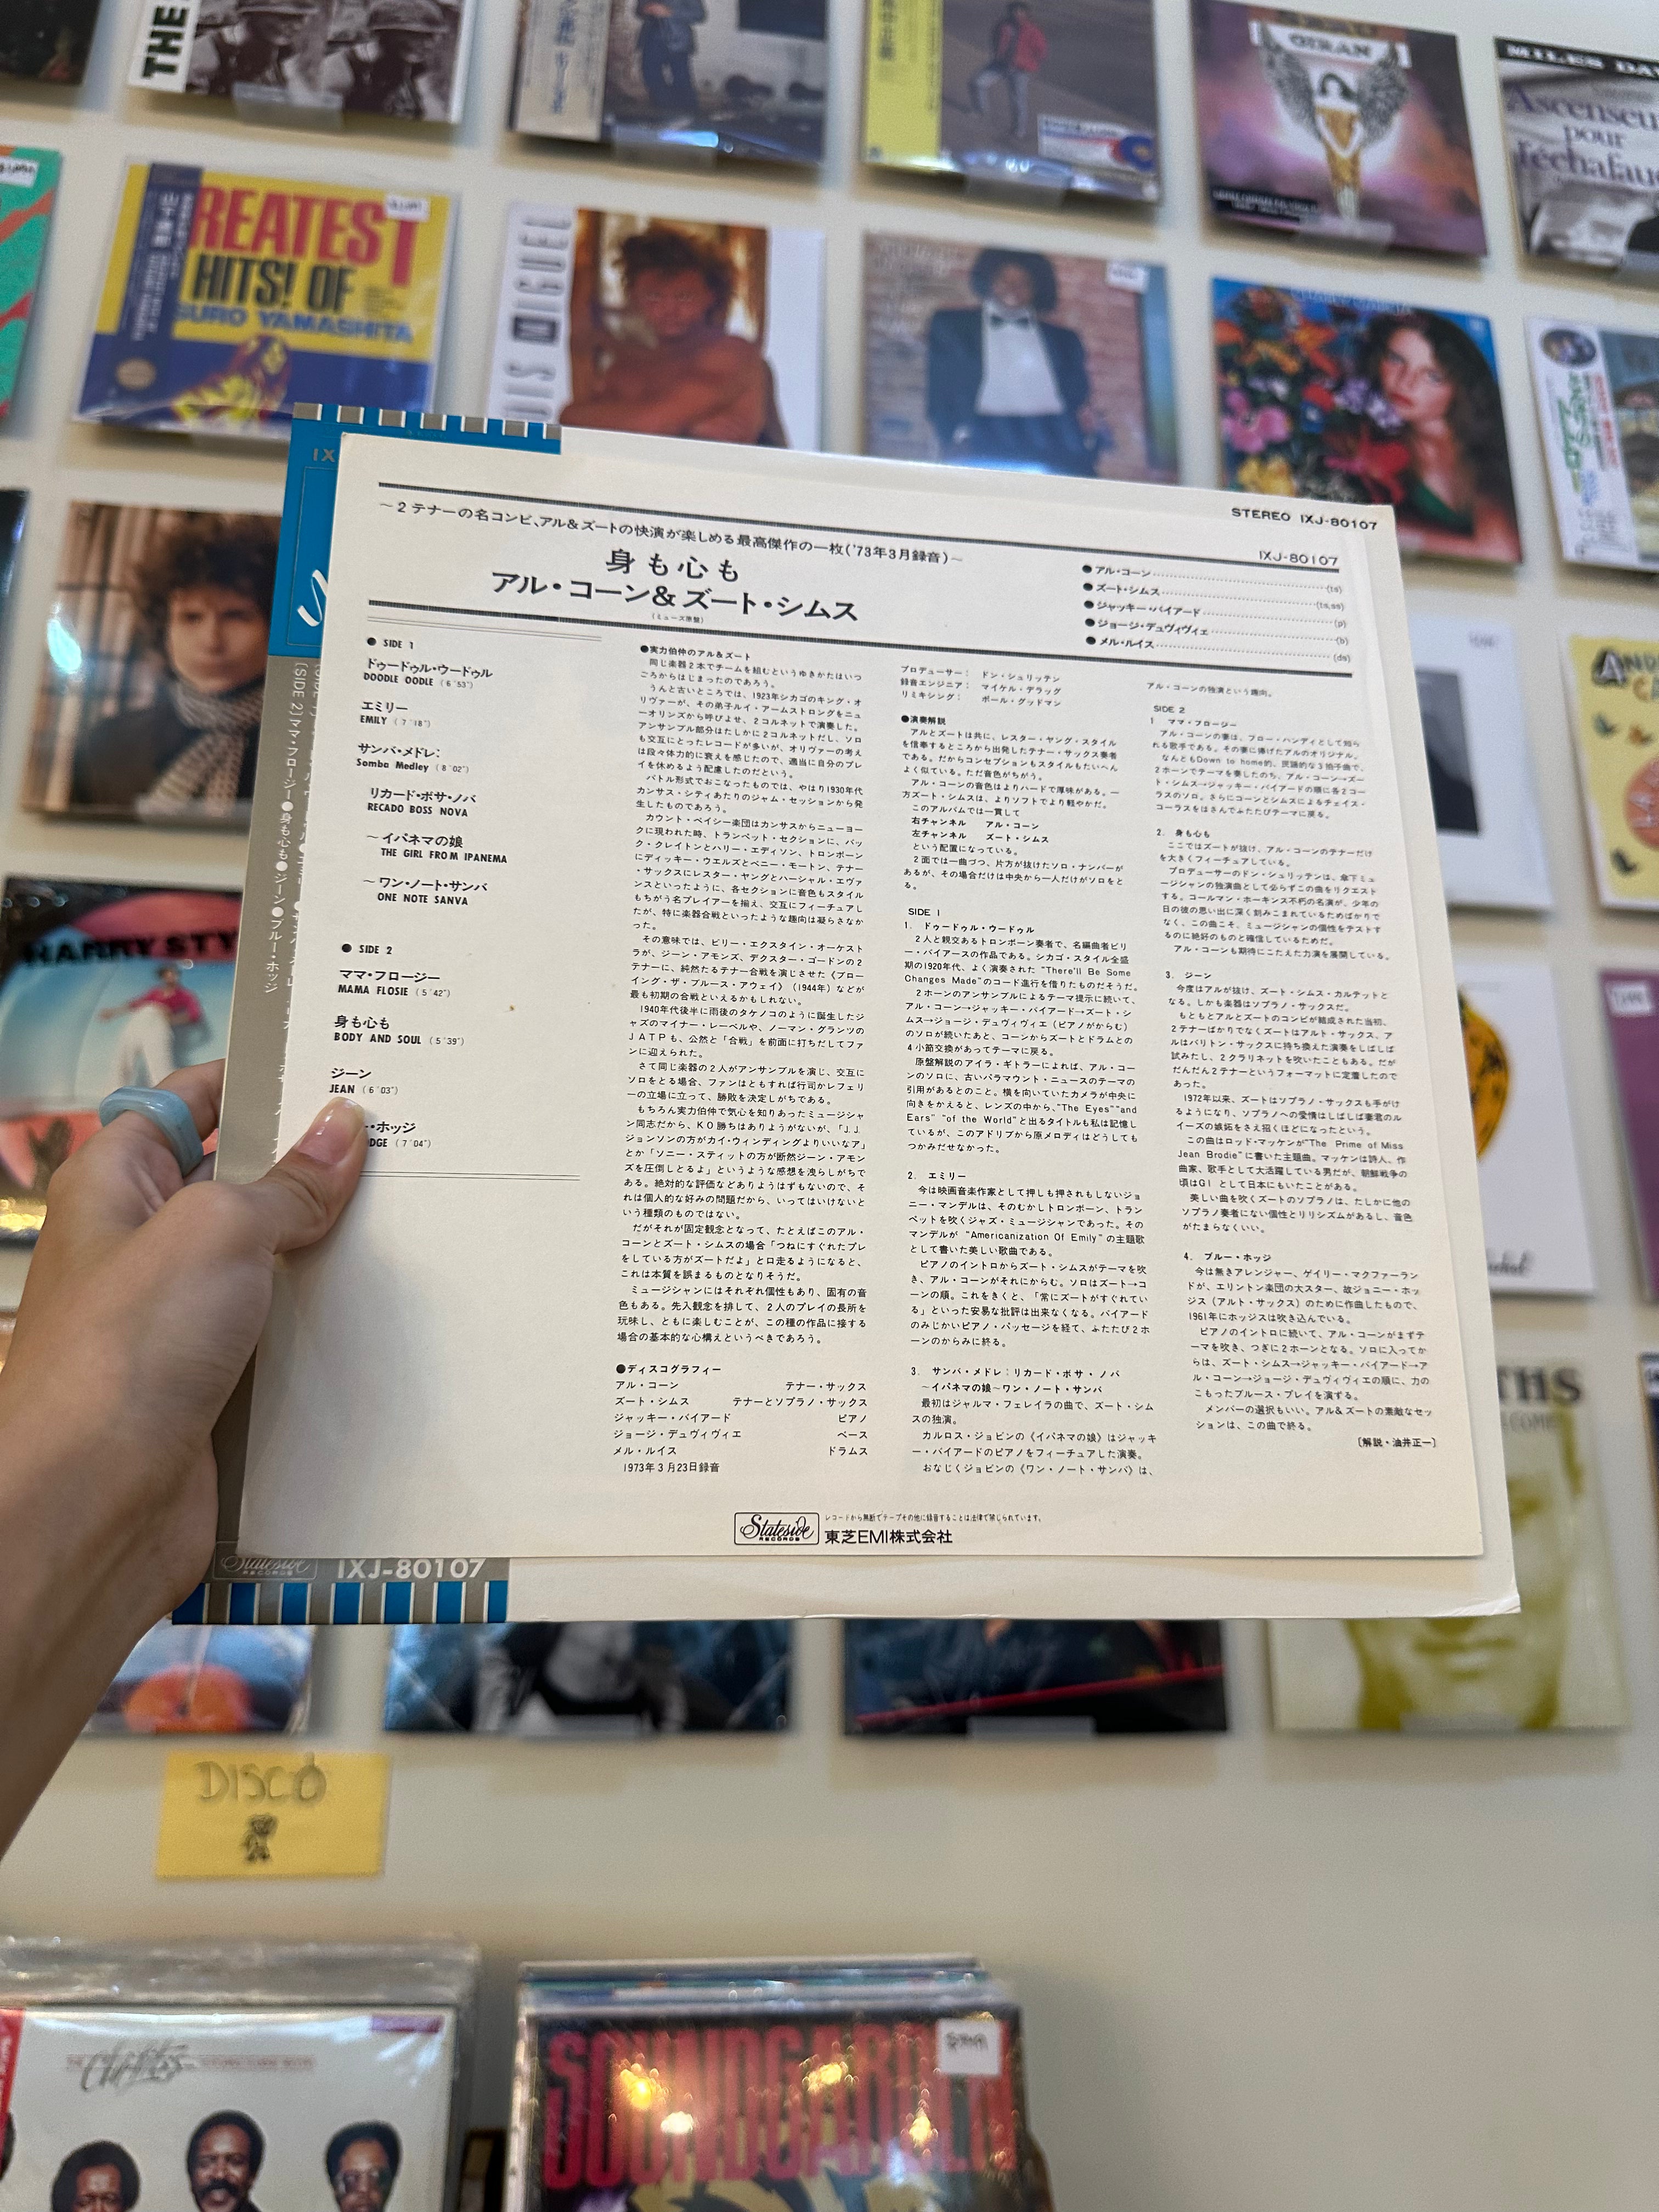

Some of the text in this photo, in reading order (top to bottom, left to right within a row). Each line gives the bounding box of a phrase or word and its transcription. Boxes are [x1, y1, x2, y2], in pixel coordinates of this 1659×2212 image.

[193, 253, 358, 313] HITS! OF
[258, 311, 414, 345] YAMASHITA
[1231, 507, 1378, 531] STEREO IXJ-80107
[1259, 550, 1339, 566] IXJ-80107
[382, 638, 414, 650] SIDE 1
[363, 671, 399, 684] DOODLE
[404, 675, 434, 687] OODLE
[361, 700, 409, 714] エミリー
[1153, 704, 1186, 714] SIDE 2
[359, 714, 388, 725] EMILY
[394, 760, 430, 774] Medley
[370, 787, 477, 804] リカード・ボサ・ノバ
[366, 802, 469, 818] RECADO BOSS NOVA
[380, 847, 398, 857] THE
[403, 848, 424, 859] GIRL
[464, 852, 507, 864] IPANEMA
[376, 892, 469, 906] ONE NOTE SANVA
[907, 907, 940, 917] SIDE 1
[358, 944, 393, 955] SIDE 2
[338, 969, 441, 984] ママ・フロージー
[904, 974, 946, 985] Changes
[1184, 972, 1212, 980] ジーン
[337, 984, 370, 995] MAMA
[376, 985, 409, 996] FLOSIE
[334, 1014, 390, 1030] 身も心も
[333, 1031, 364, 1042] BODY
[369, 1033, 392, 1043] AND
[396, 1034, 422, 1045] SOUL
[330, 1067, 373, 1080] ジーン
[328, 1084, 356, 1094] JEAN
[928, 1171, 967, 1181] エミリー
[740, 1513, 814, 1538] Stateside
[825, 1529, 952, 1544] 東芝EMI株式会社
[337, 1558, 487, 1579] IXJ-80107
[199, 1753, 328, 1803] DISCO
